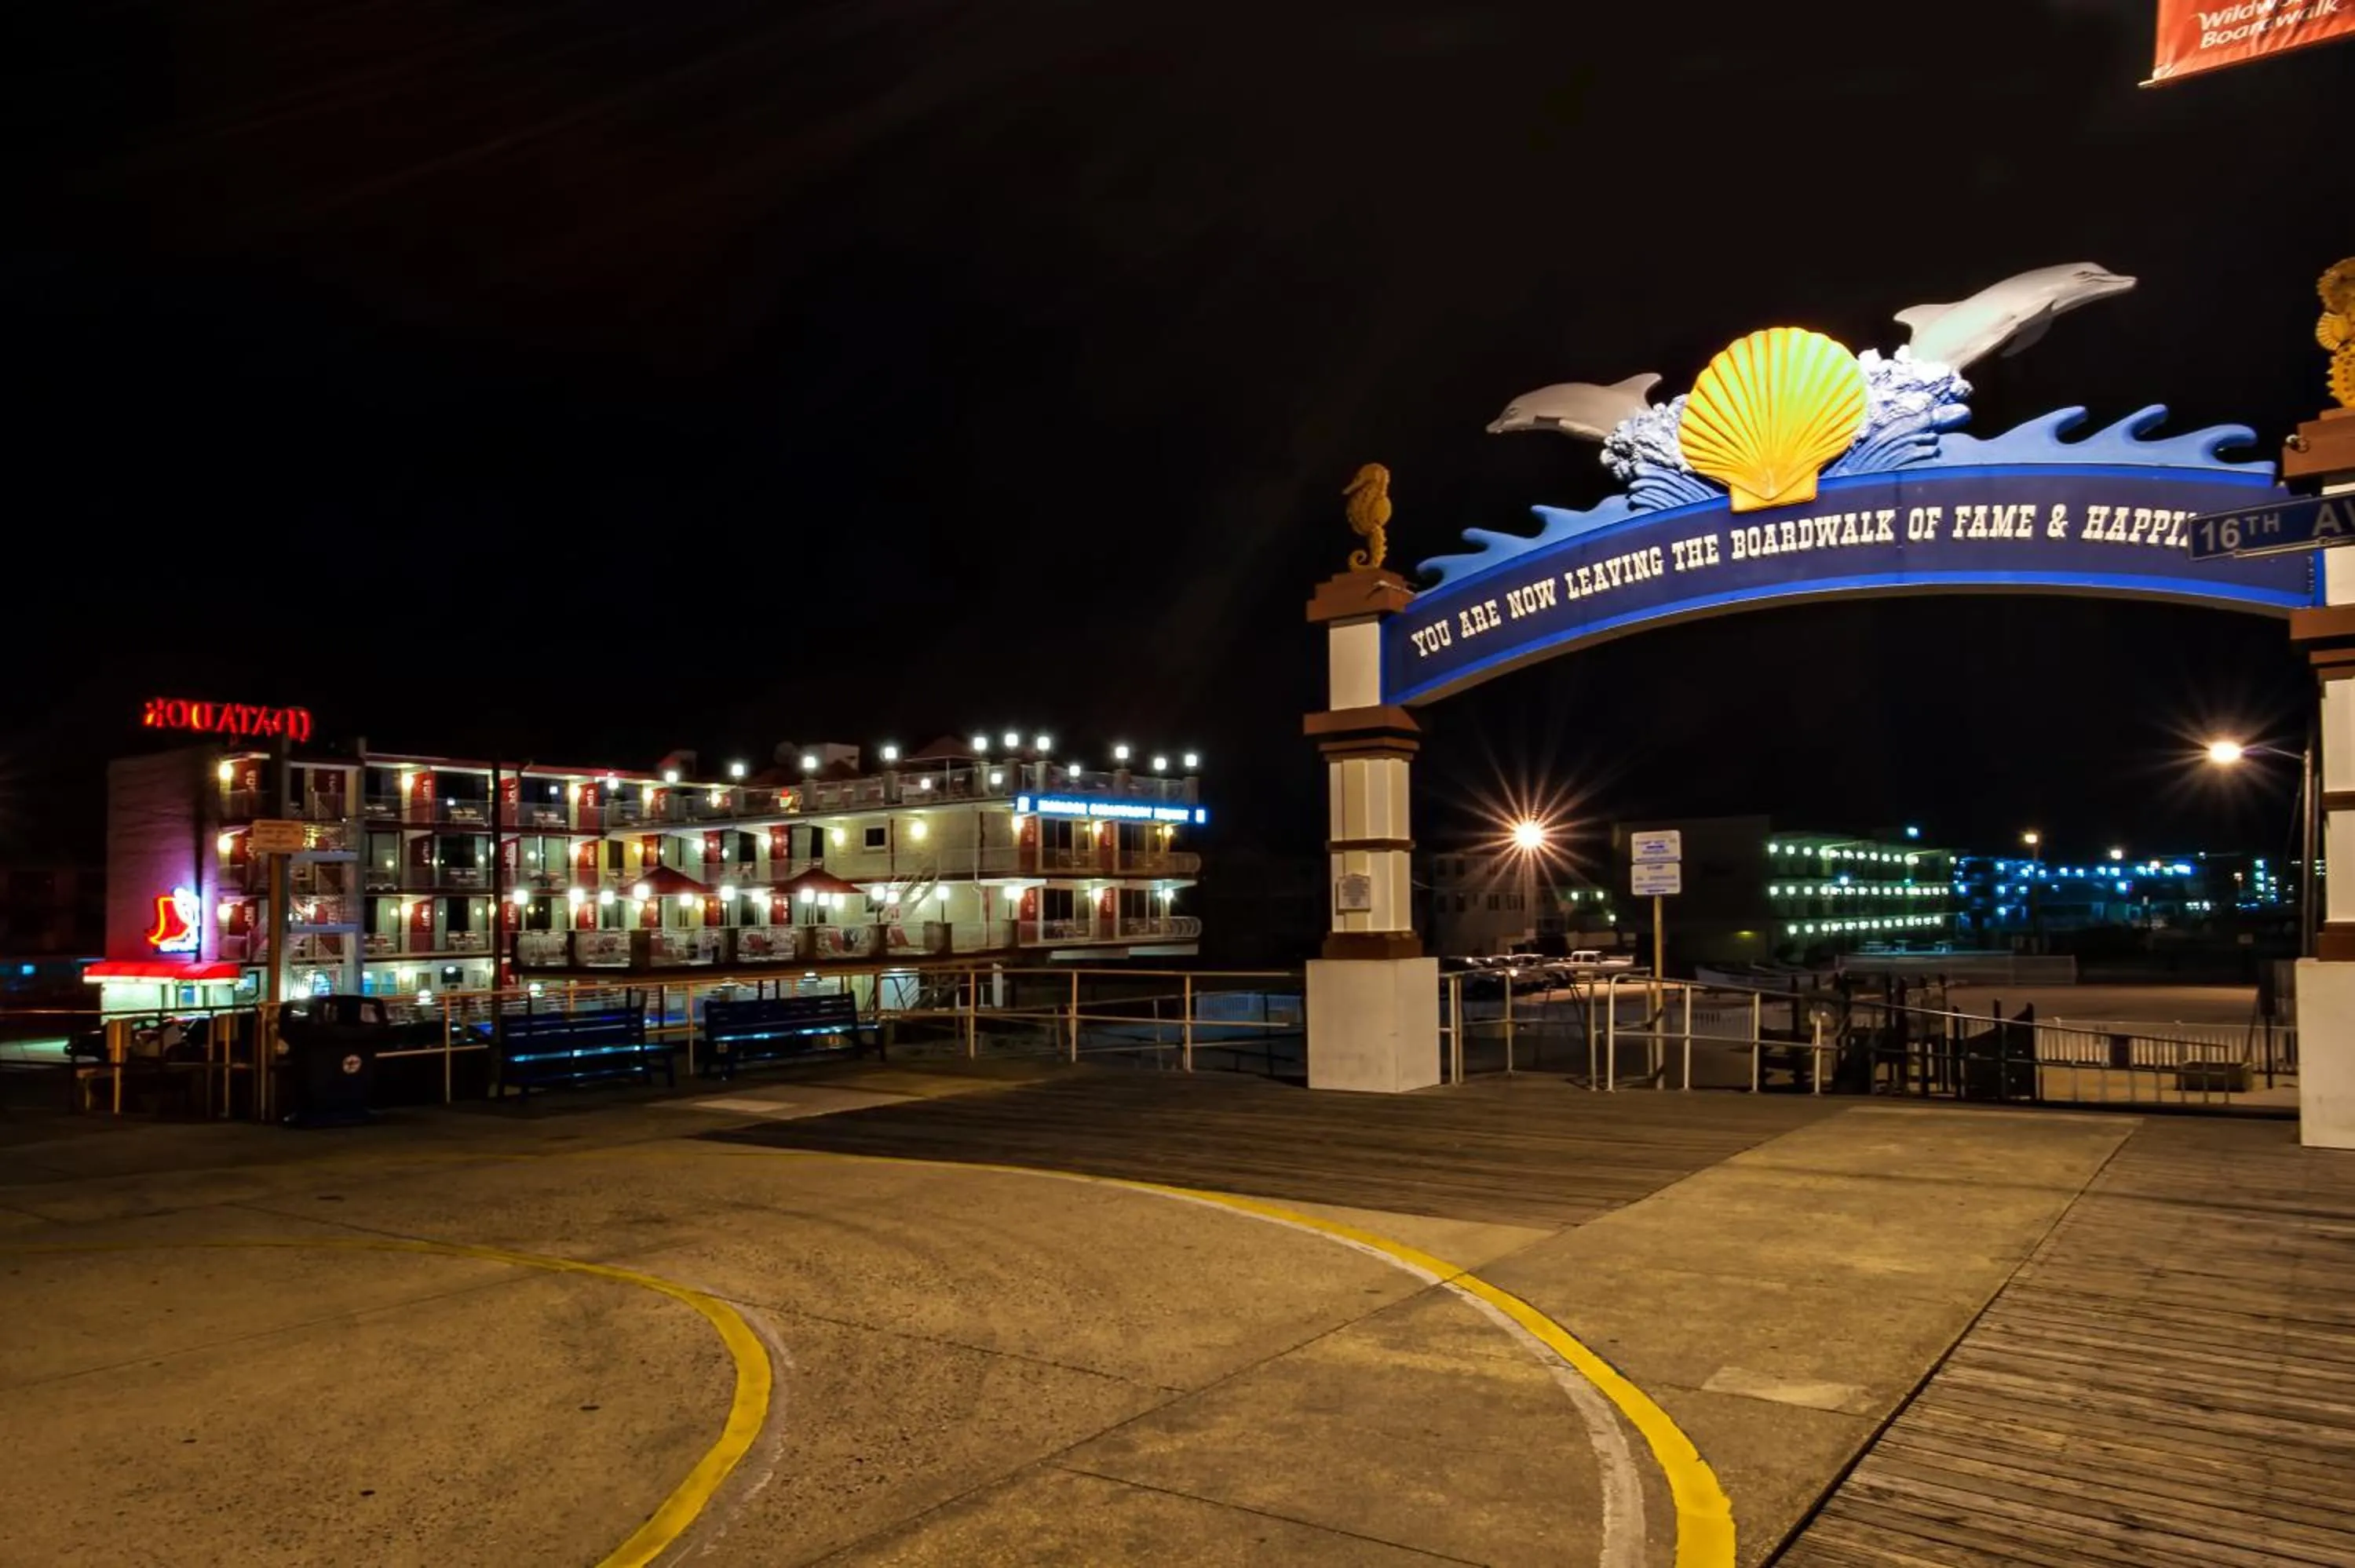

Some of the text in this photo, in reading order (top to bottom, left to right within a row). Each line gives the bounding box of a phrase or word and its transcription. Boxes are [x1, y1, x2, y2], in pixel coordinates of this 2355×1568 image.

[2200, 512, 2280, 550] 16TH
[1411, 619, 1451, 657] YOU
[1459, 599, 1502, 638] ARE
[1506, 578, 1557, 619] NOW
[1564, 546, 1664, 600] LEAVING
[1671, 534, 1720, 571] THE
[1730, 509, 1896, 560] BOARDWALK
[1907, 506, 1943, 541] OF
[1952, 504, 2037, 538] FAME
[2046, 503, 2068, 538] &
